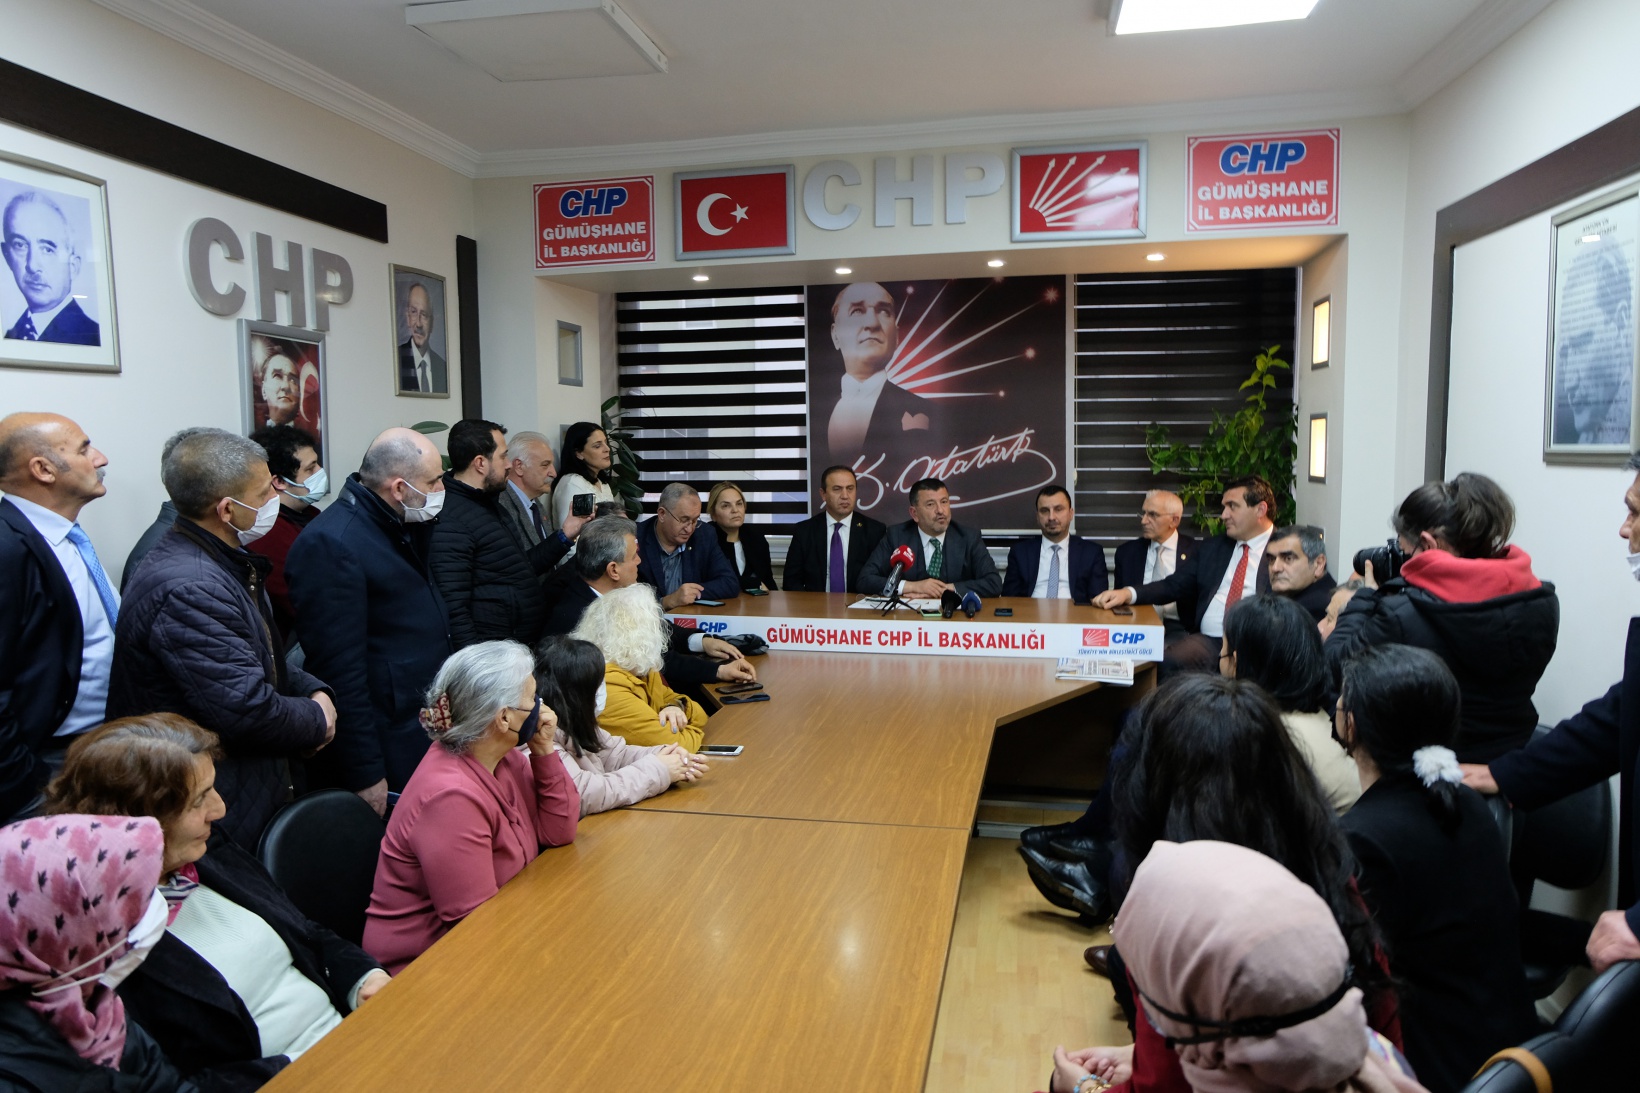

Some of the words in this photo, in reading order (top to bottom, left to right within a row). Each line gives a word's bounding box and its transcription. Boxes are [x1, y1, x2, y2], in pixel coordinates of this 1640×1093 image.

[1219, 140, 1306, 177] CHP
[803, 152, 1006, 231] CHP
[1198, 180, 1328, 201] GÜMÜŞHANE
[559, 186, 628, 219] CHP
[1198, 204, 1213, 221] İL
[1219, 199, 1327, 220] BAŞKANLIĞI
[543, 221, 647, 240] GÜMÜŞHANE
[544, 244, 557, 258] İL
[561, 238, 646, 257] BAŞKANLIĞI
[183, 217, 354, 332] CHP
[699, 621, 728, 633] CHP
[767, 624, 872, 647] GÜMÜŞHANE
[877, 630, 912, 647] CHP
[918, 627, 932, 648] İL
[939, 628, 1045, 650] BAŞKANLIĞI
[1112, 632, 1145, 644] CHP
